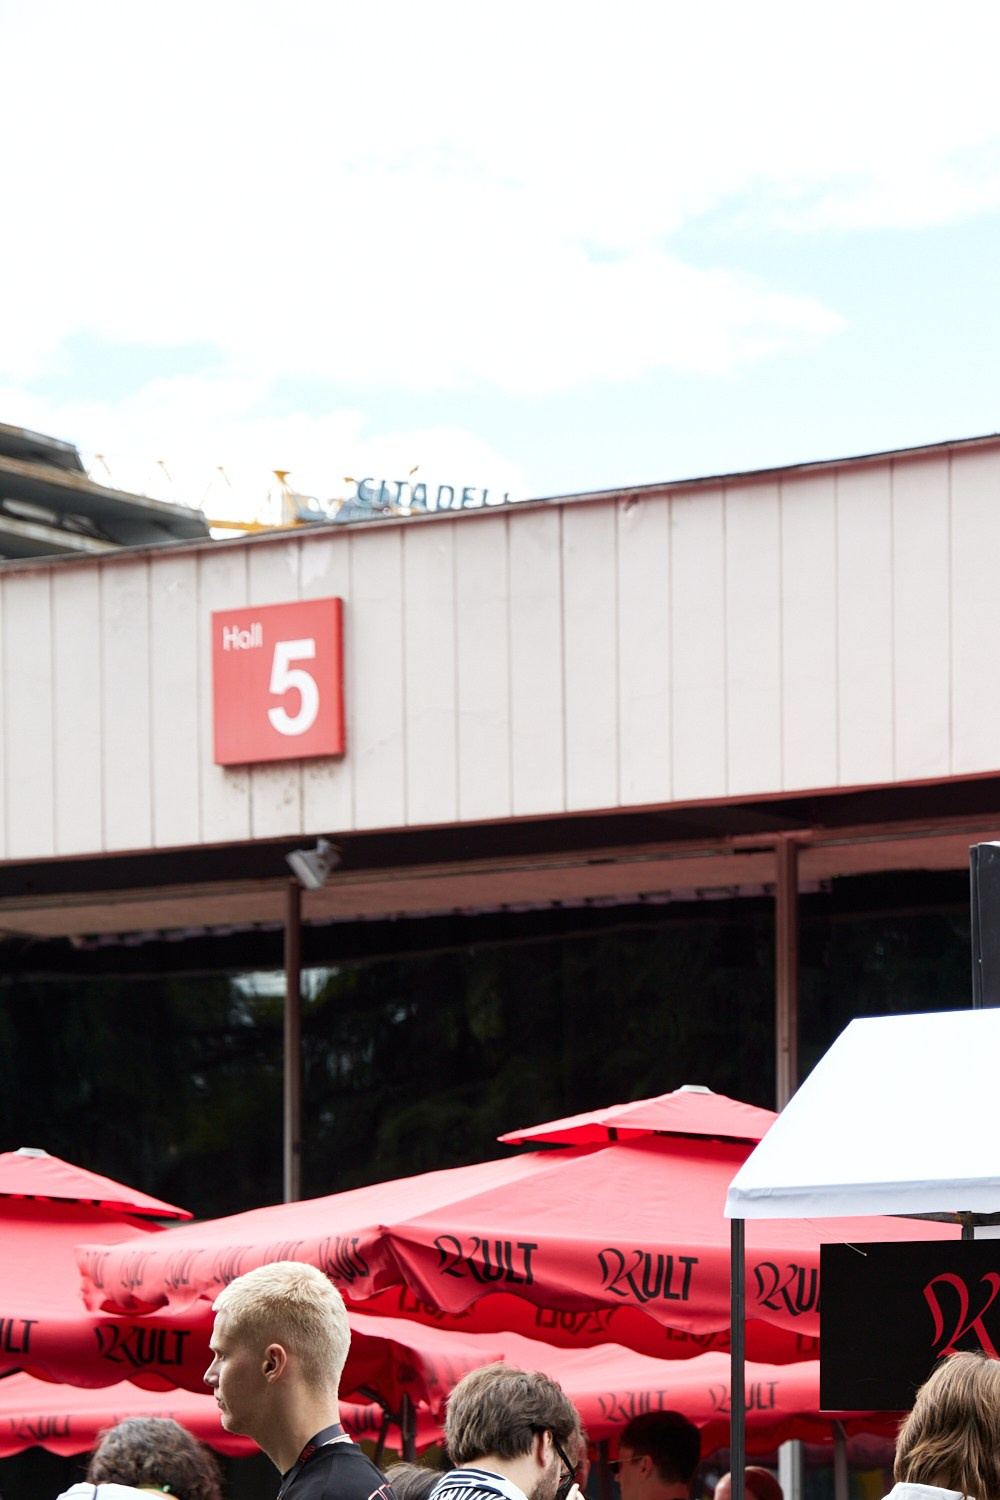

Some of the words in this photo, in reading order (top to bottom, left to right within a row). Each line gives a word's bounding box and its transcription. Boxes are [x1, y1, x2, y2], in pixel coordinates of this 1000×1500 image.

[223, 623, 263, 650] Hall
[267, 637, 319, 736] 5
[434, 1235, 538, 1285] KULT
[597, 1248, 699, 1304] KULT
[753, 1261, 821, 1317] KU
[95, 1324, 191, 1368] KULT
